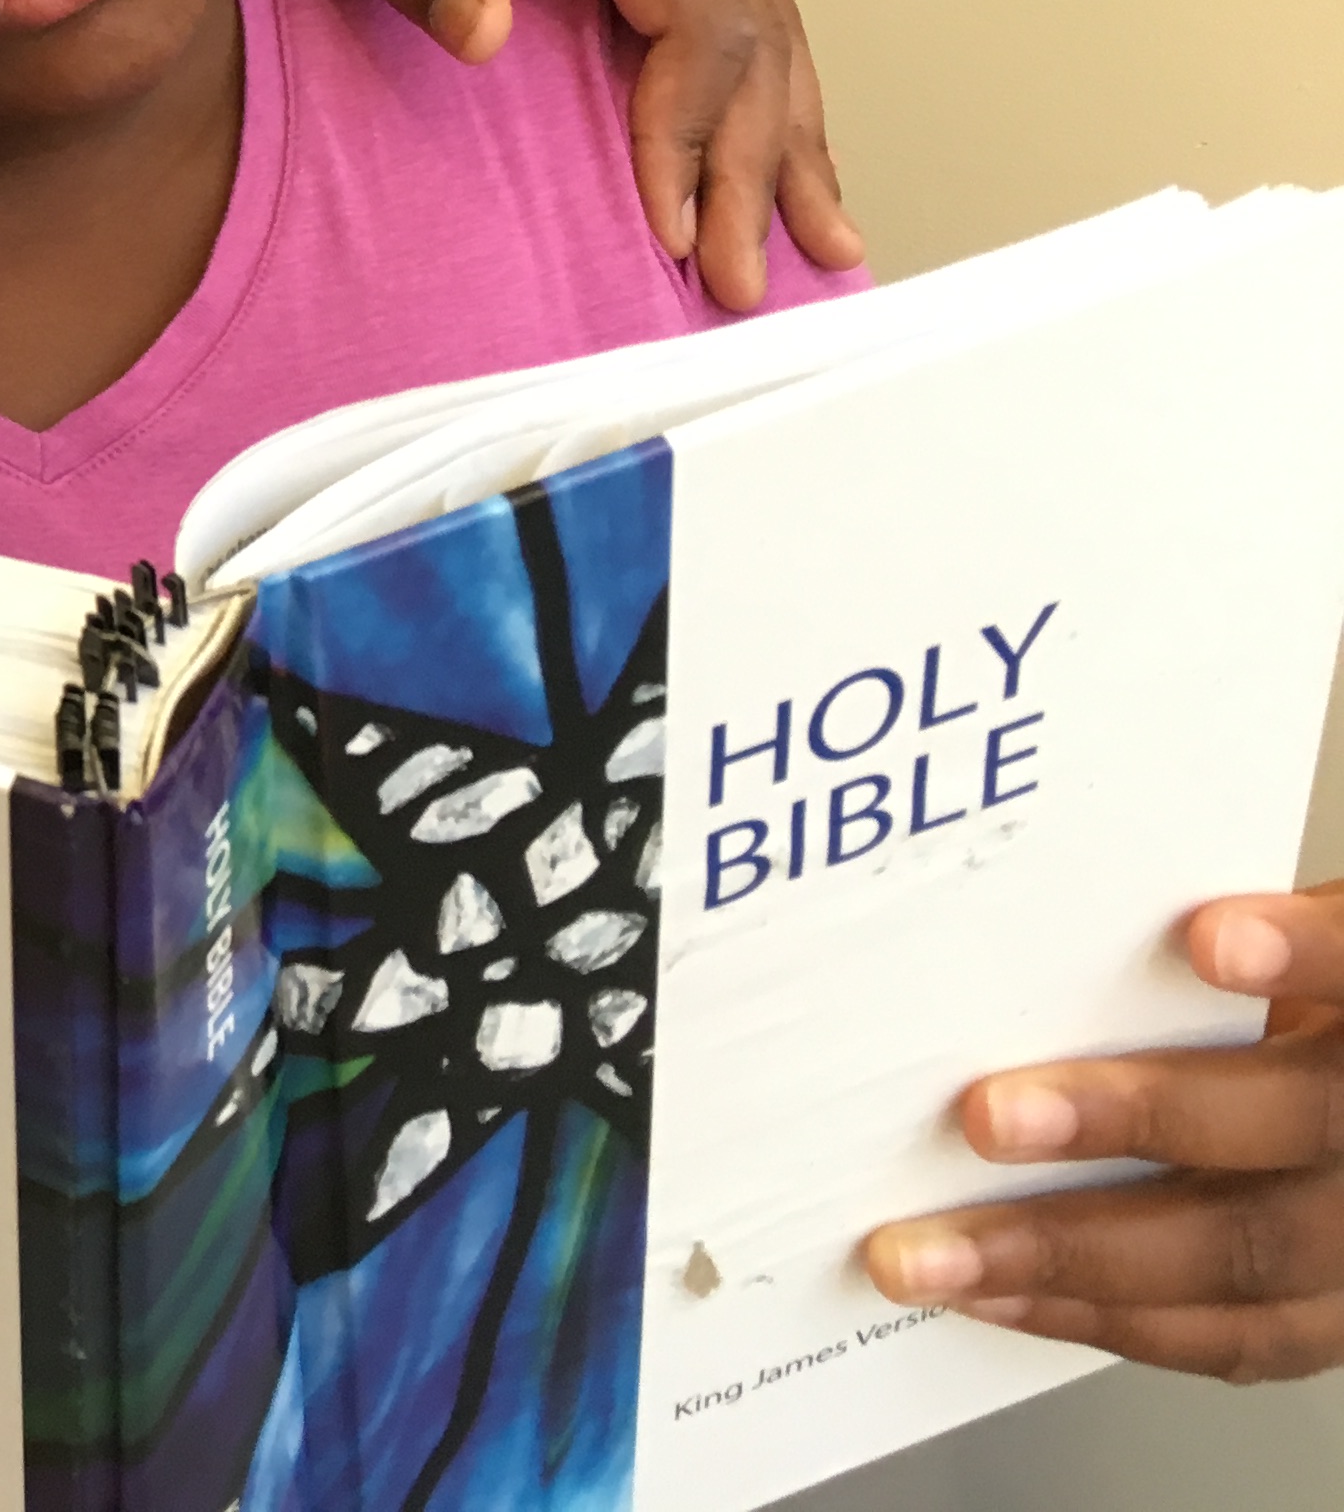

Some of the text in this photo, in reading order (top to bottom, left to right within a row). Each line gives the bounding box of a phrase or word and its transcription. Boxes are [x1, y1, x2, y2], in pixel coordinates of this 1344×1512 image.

[708, 600, 1061, 809] HOLY
[703, 711, 1046, 912] BIBLE
[205, 800, 236, 1063] HOLY BIBLE
[673, 1300, 950, 1422] King James Versio
